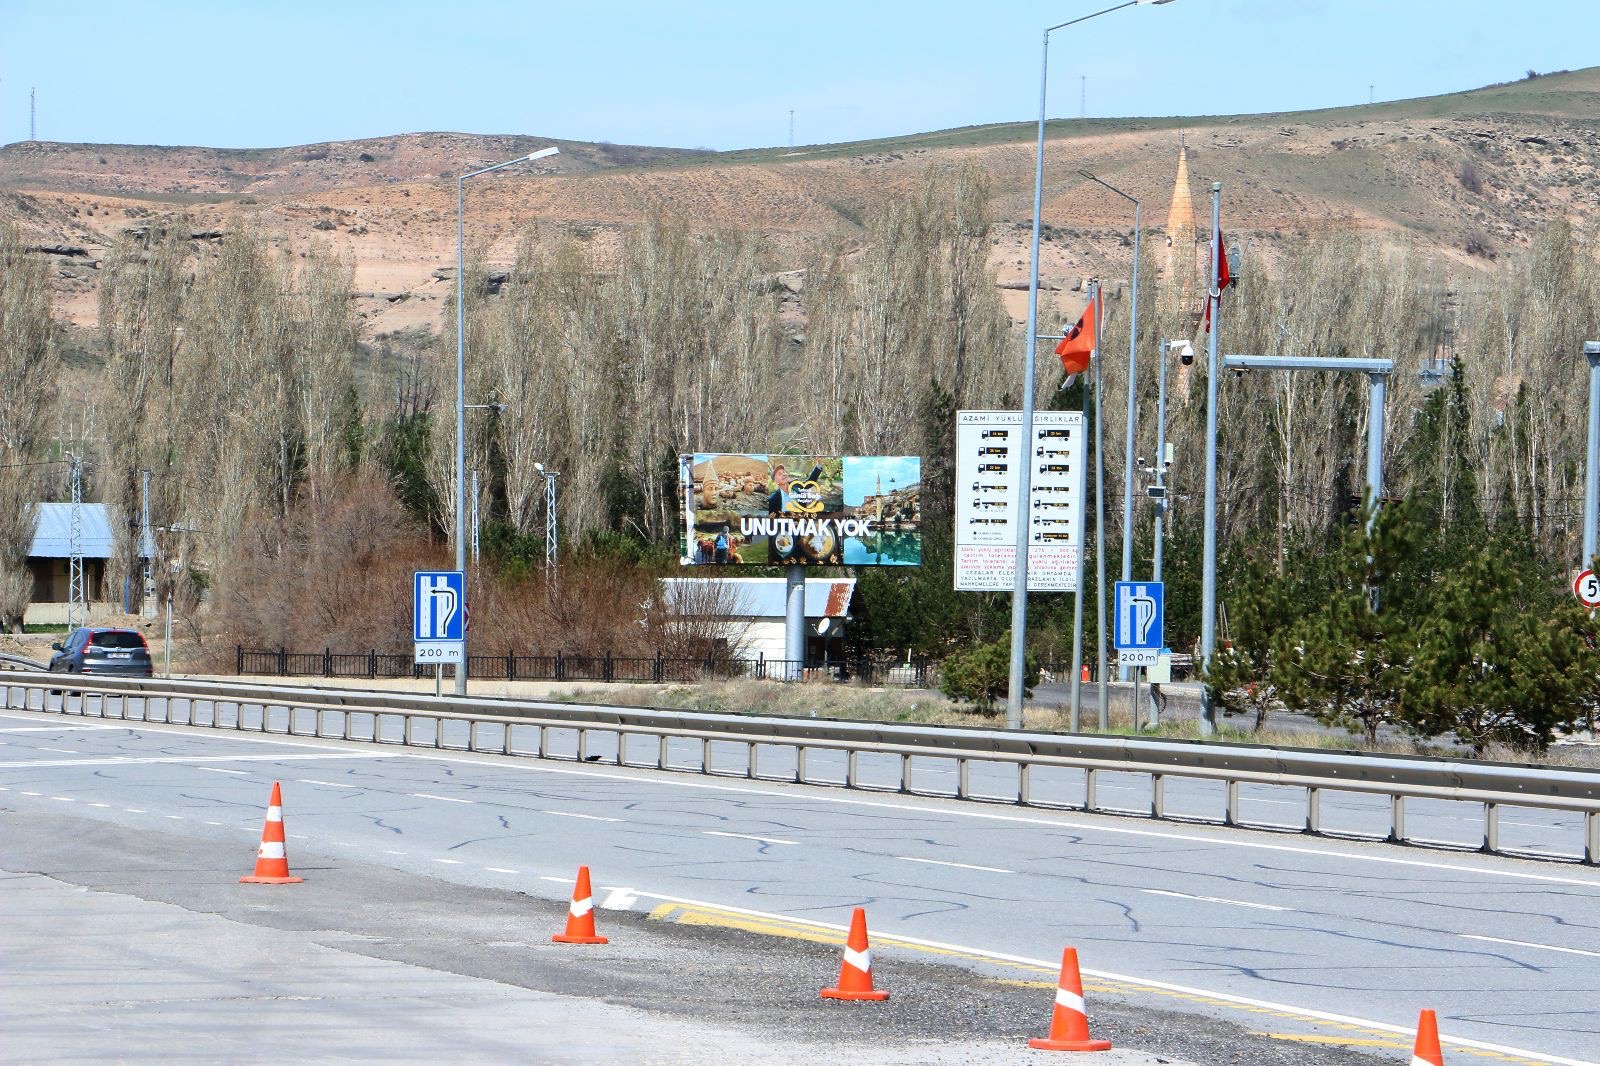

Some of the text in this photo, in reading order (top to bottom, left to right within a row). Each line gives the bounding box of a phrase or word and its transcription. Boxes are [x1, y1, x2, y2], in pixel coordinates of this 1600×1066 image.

[996, 414, 1023, 422] YÜKLÜ
[1034, 415, 1080, 423] ĞIRLIKLAR
[740, 518, 871, 536] UNUTMAK YOK
[1588, 580, 1600, 597] 5
